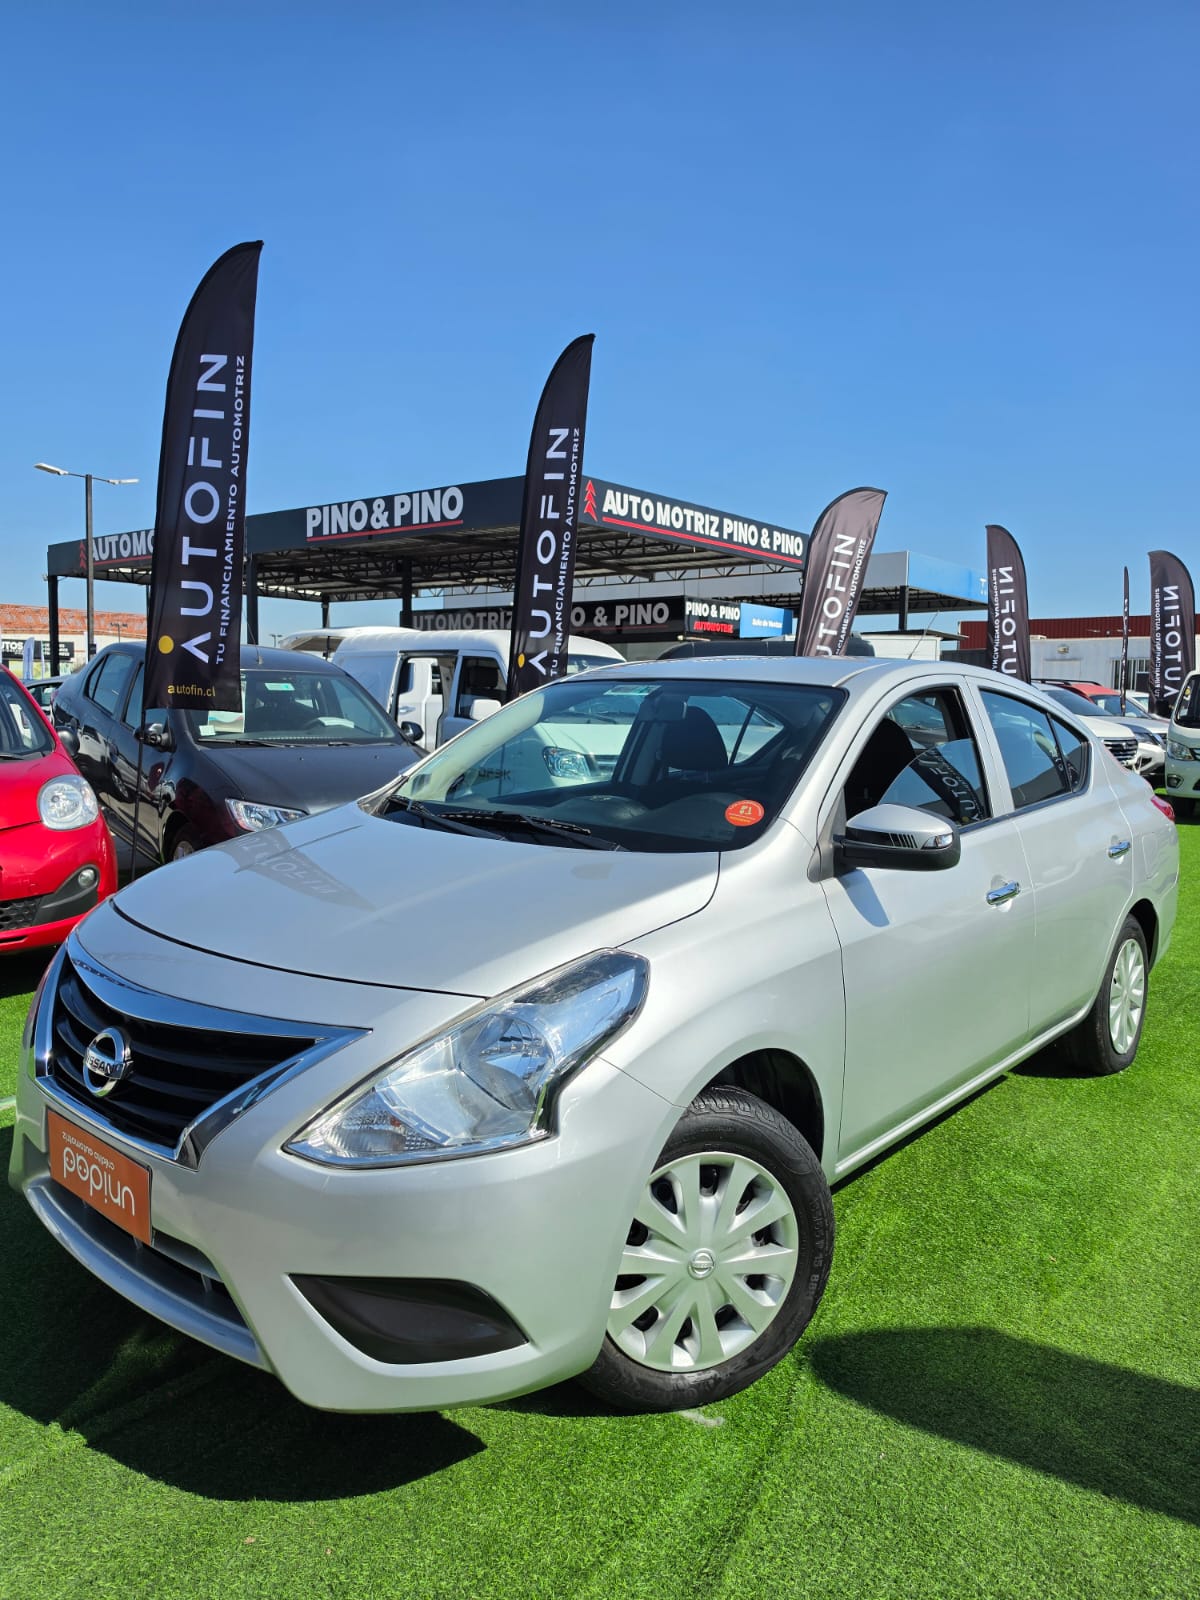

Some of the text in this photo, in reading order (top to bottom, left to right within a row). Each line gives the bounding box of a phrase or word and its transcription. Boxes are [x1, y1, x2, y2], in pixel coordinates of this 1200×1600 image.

[180, 354, 228, 664] AUTOFIN
[216, 355, 245, 665] TU FINANCIAMIENTO AUTOMOTRIZ
[722, 519, 758, 546] PINO
[760, 527, 771, 549] &
[772, 531, 804, 557] PINO
[528, 428, 569, 676] AUTOFIN
[550, 427, 580, 677] TU FINANCIAMIENTO AUTOMOTRIZ
[849, 538, 867, 598] AUTOMOTRIZ
[593, 606, 609, 628] &
[615, 602, 670, 626] PINO
[685, 601, 740, 621] PINO & PINO
[63, 1146, 136, 1216] unidad
